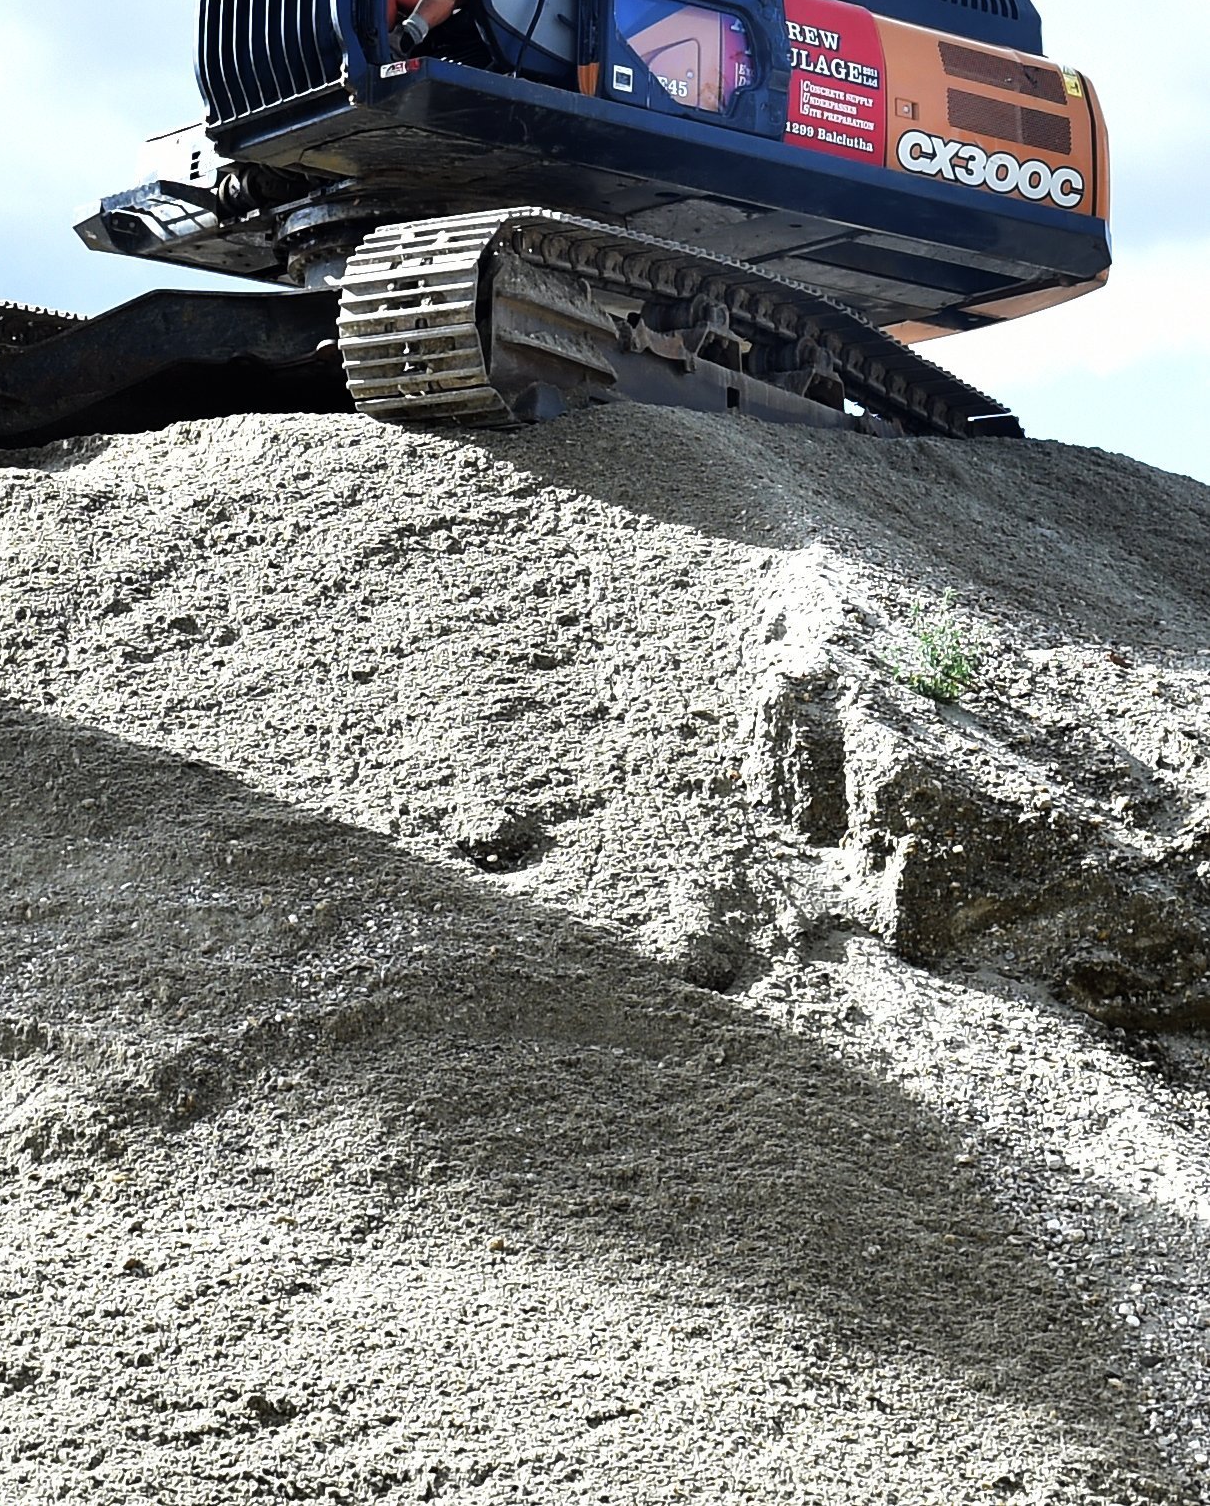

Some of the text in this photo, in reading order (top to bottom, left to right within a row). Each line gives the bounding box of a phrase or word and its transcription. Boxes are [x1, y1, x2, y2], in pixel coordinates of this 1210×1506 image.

[803, 80, 844, 100] CONCRETE
[802, 104, 875, 131] SITE PREPARATION
[785, 121, 874, 152] 1299 Balclutha
[897, 129, 1085, 209] CX300C
